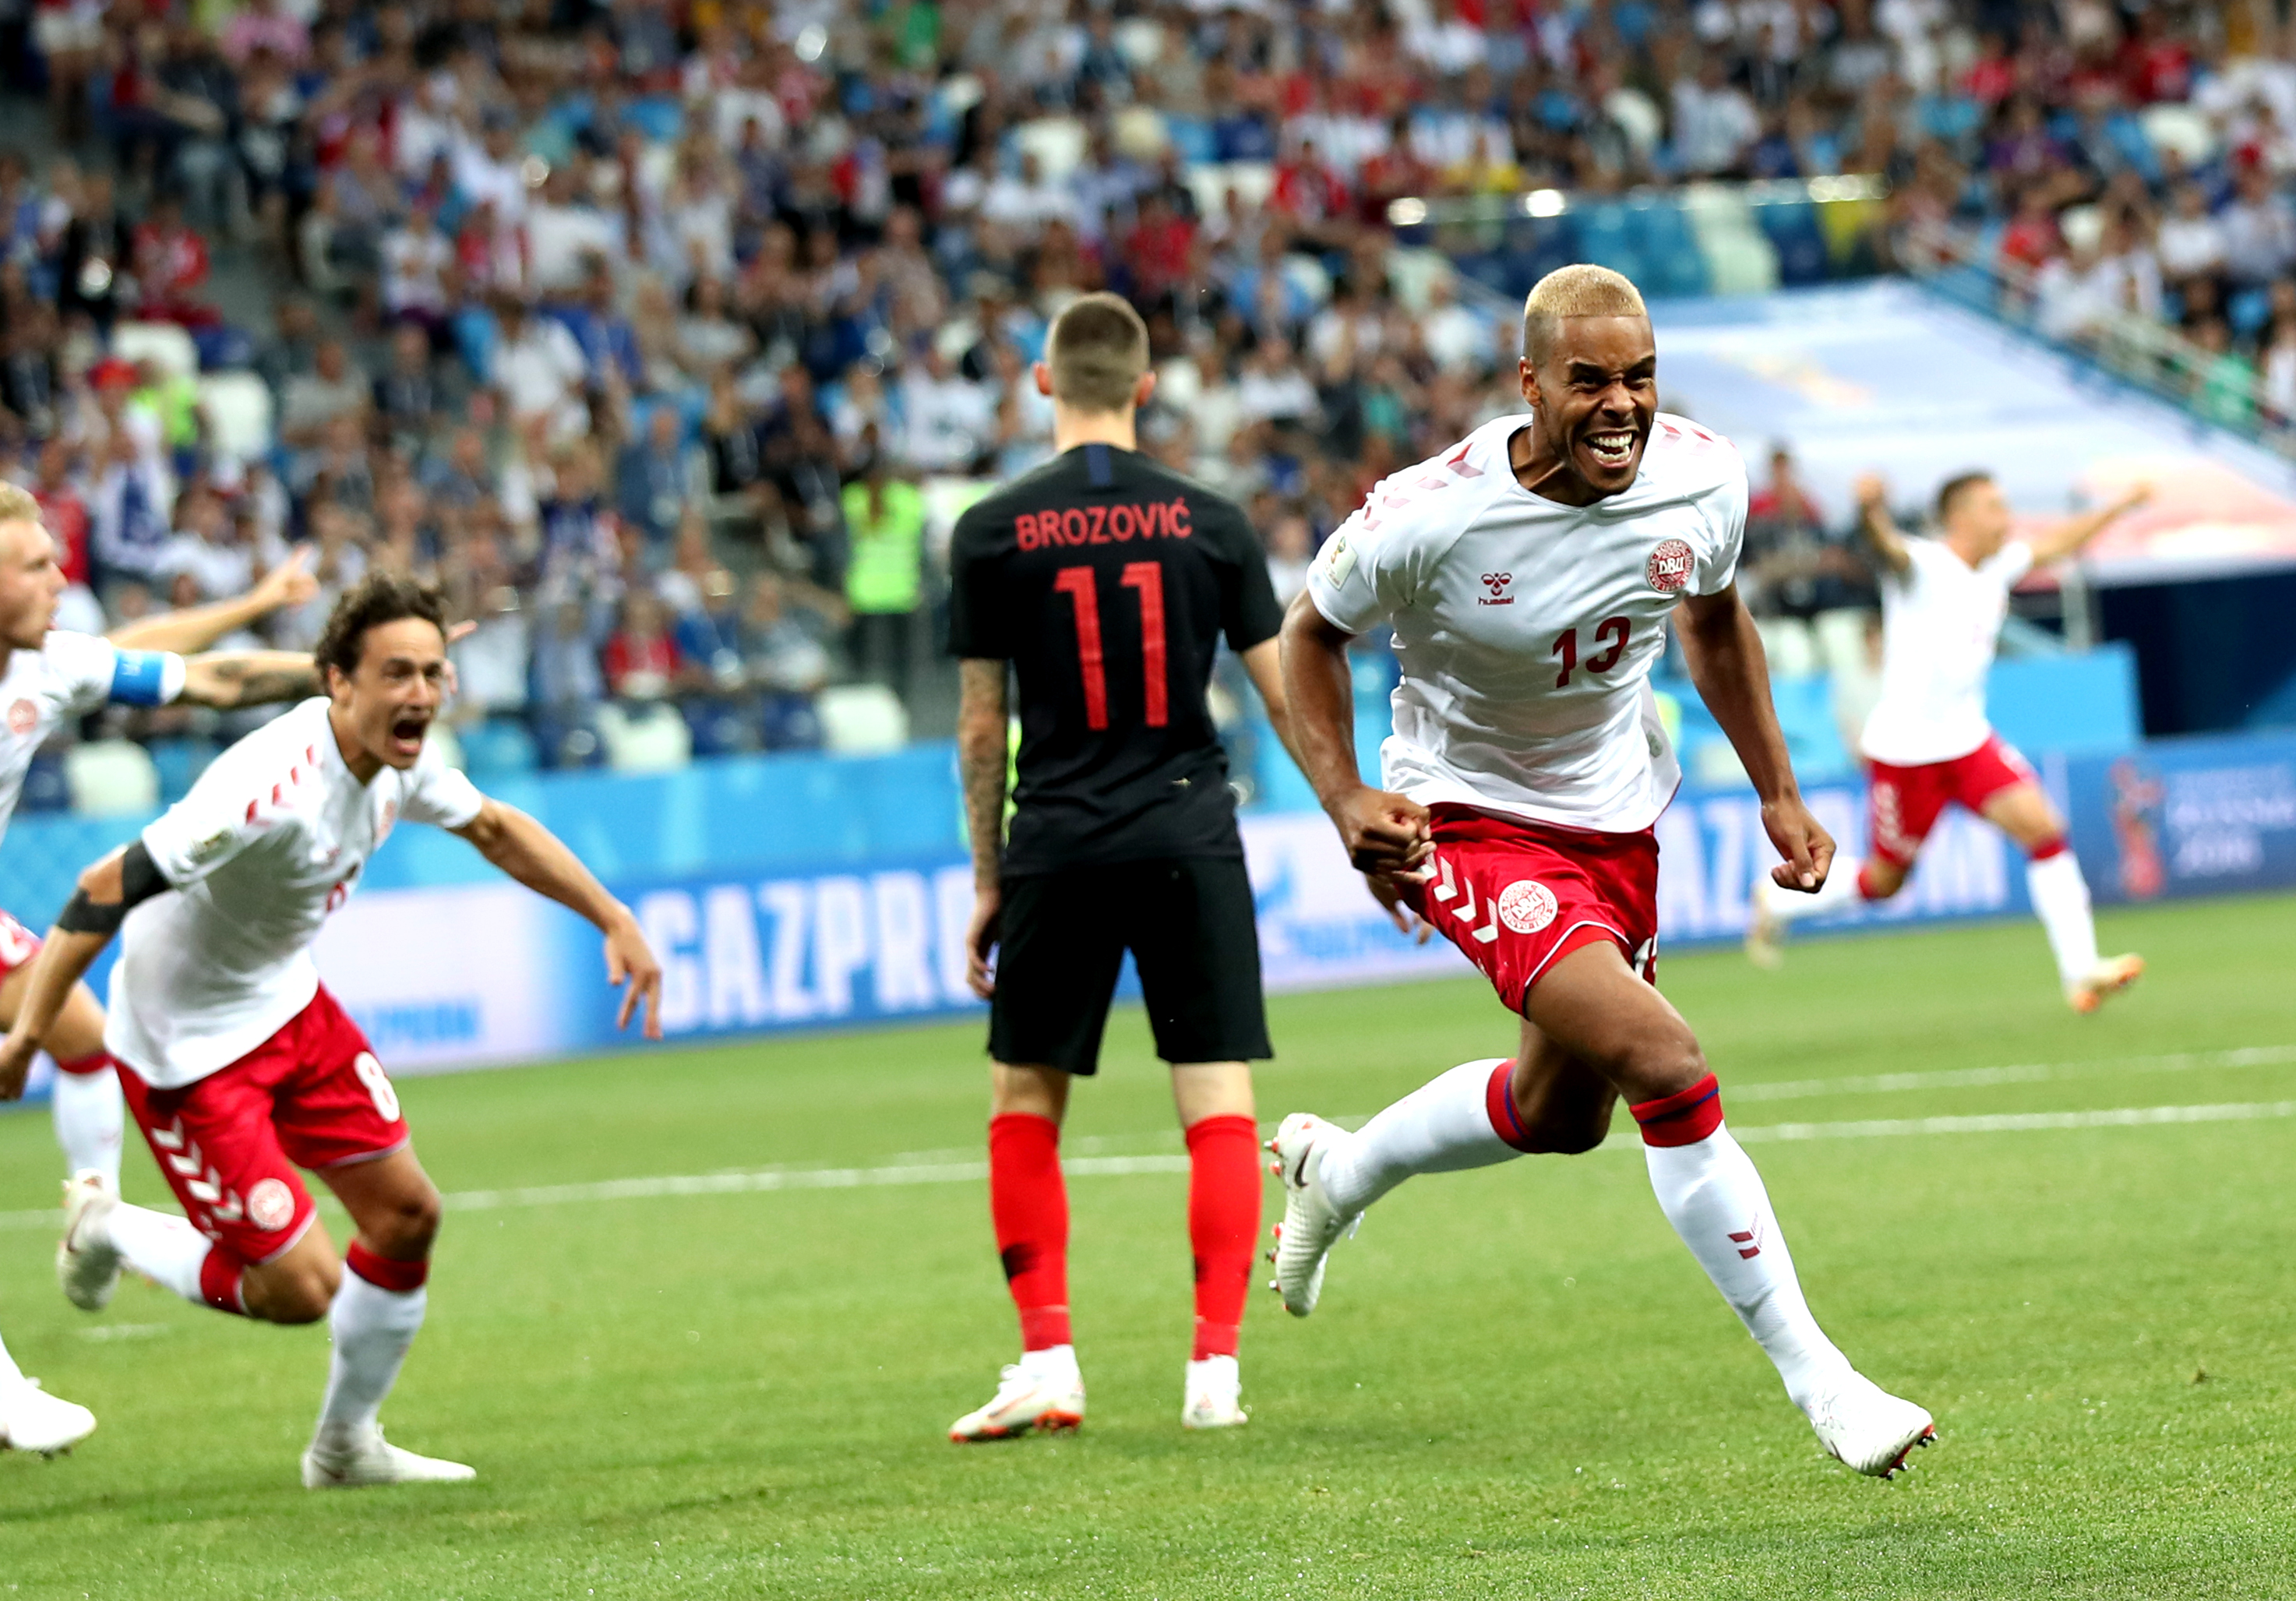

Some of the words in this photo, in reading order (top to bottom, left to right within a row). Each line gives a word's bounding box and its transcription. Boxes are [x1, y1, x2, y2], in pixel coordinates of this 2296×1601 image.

[1014, 496, 1193, 552] BROZOVIĆ
[1478, 596, 1514, 605] hummel
[1658, 556, 1684, 574] DBU
[1053, 560, 1168, 731] 11
[1552, 616, 1631, 689] 13
[640, 862, 982, 1035] GAZPRO
[353, 1051, 400, 1123] 8
